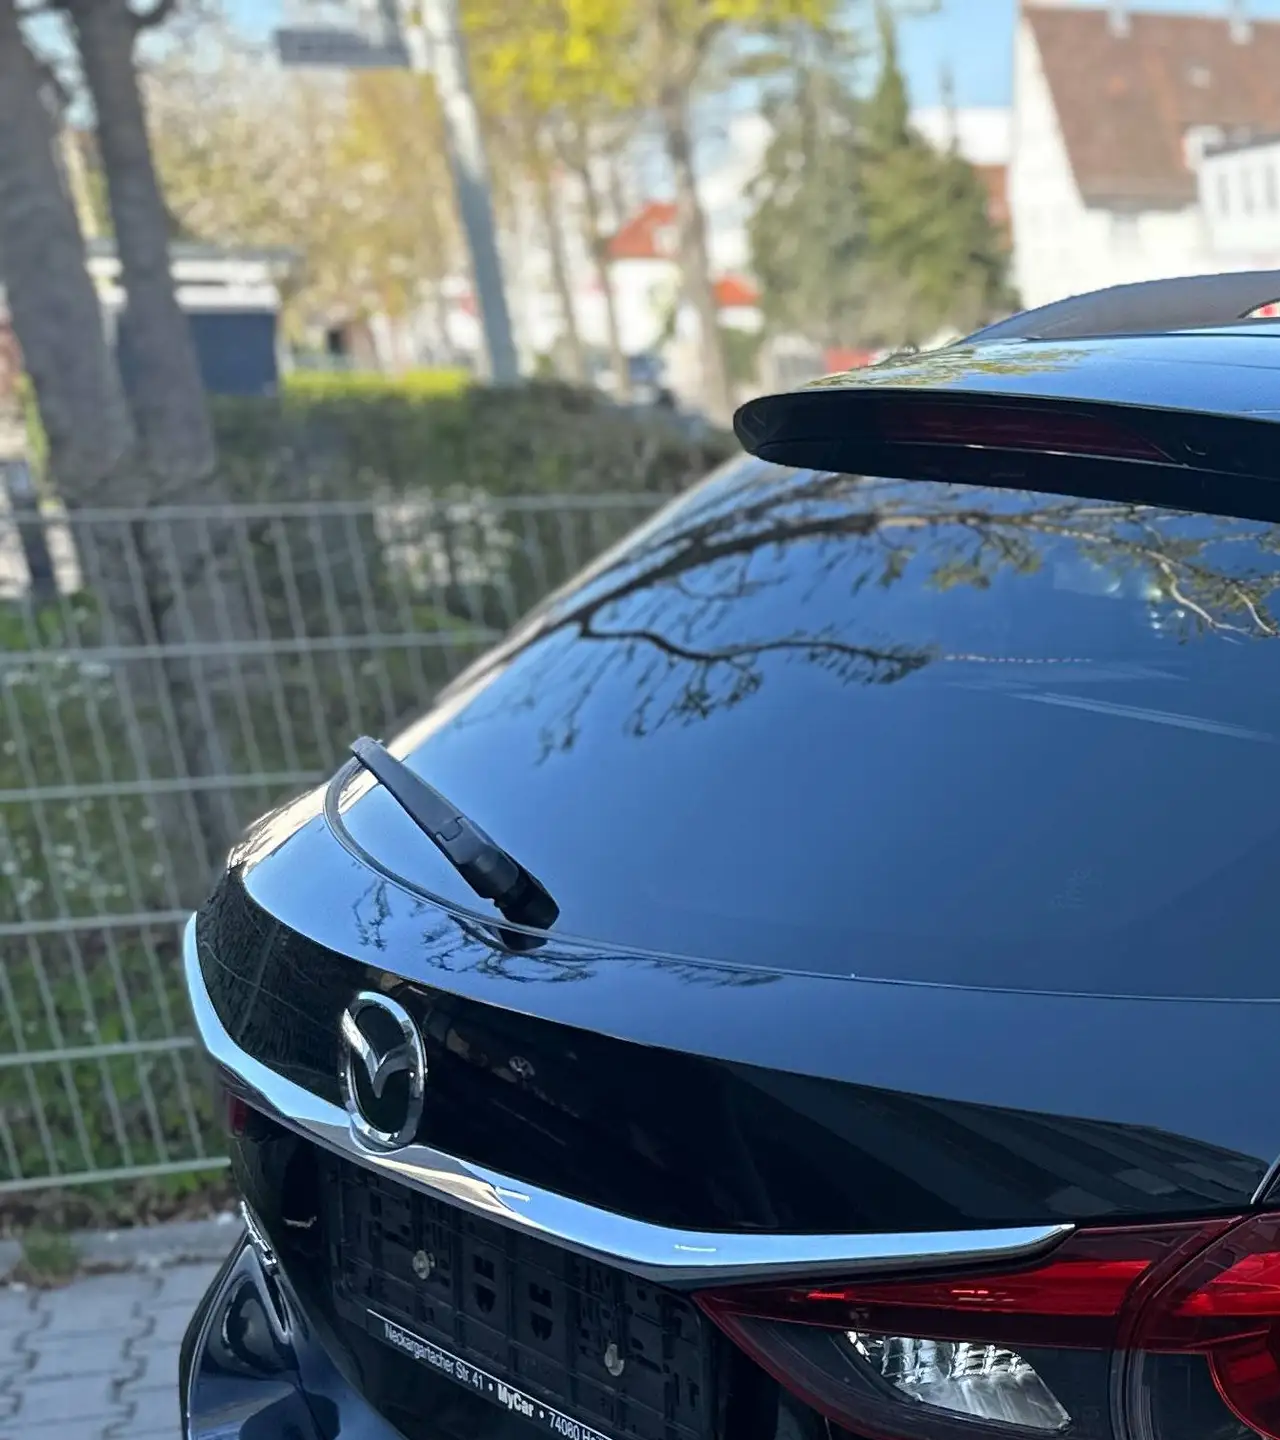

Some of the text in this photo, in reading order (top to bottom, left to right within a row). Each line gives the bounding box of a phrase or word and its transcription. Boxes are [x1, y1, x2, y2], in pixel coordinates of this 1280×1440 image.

[455, 1361, 472, 1384] Str.
[472, 1372, 484, 1390] 41
[497, 1383, 534, 1418] MyCar
